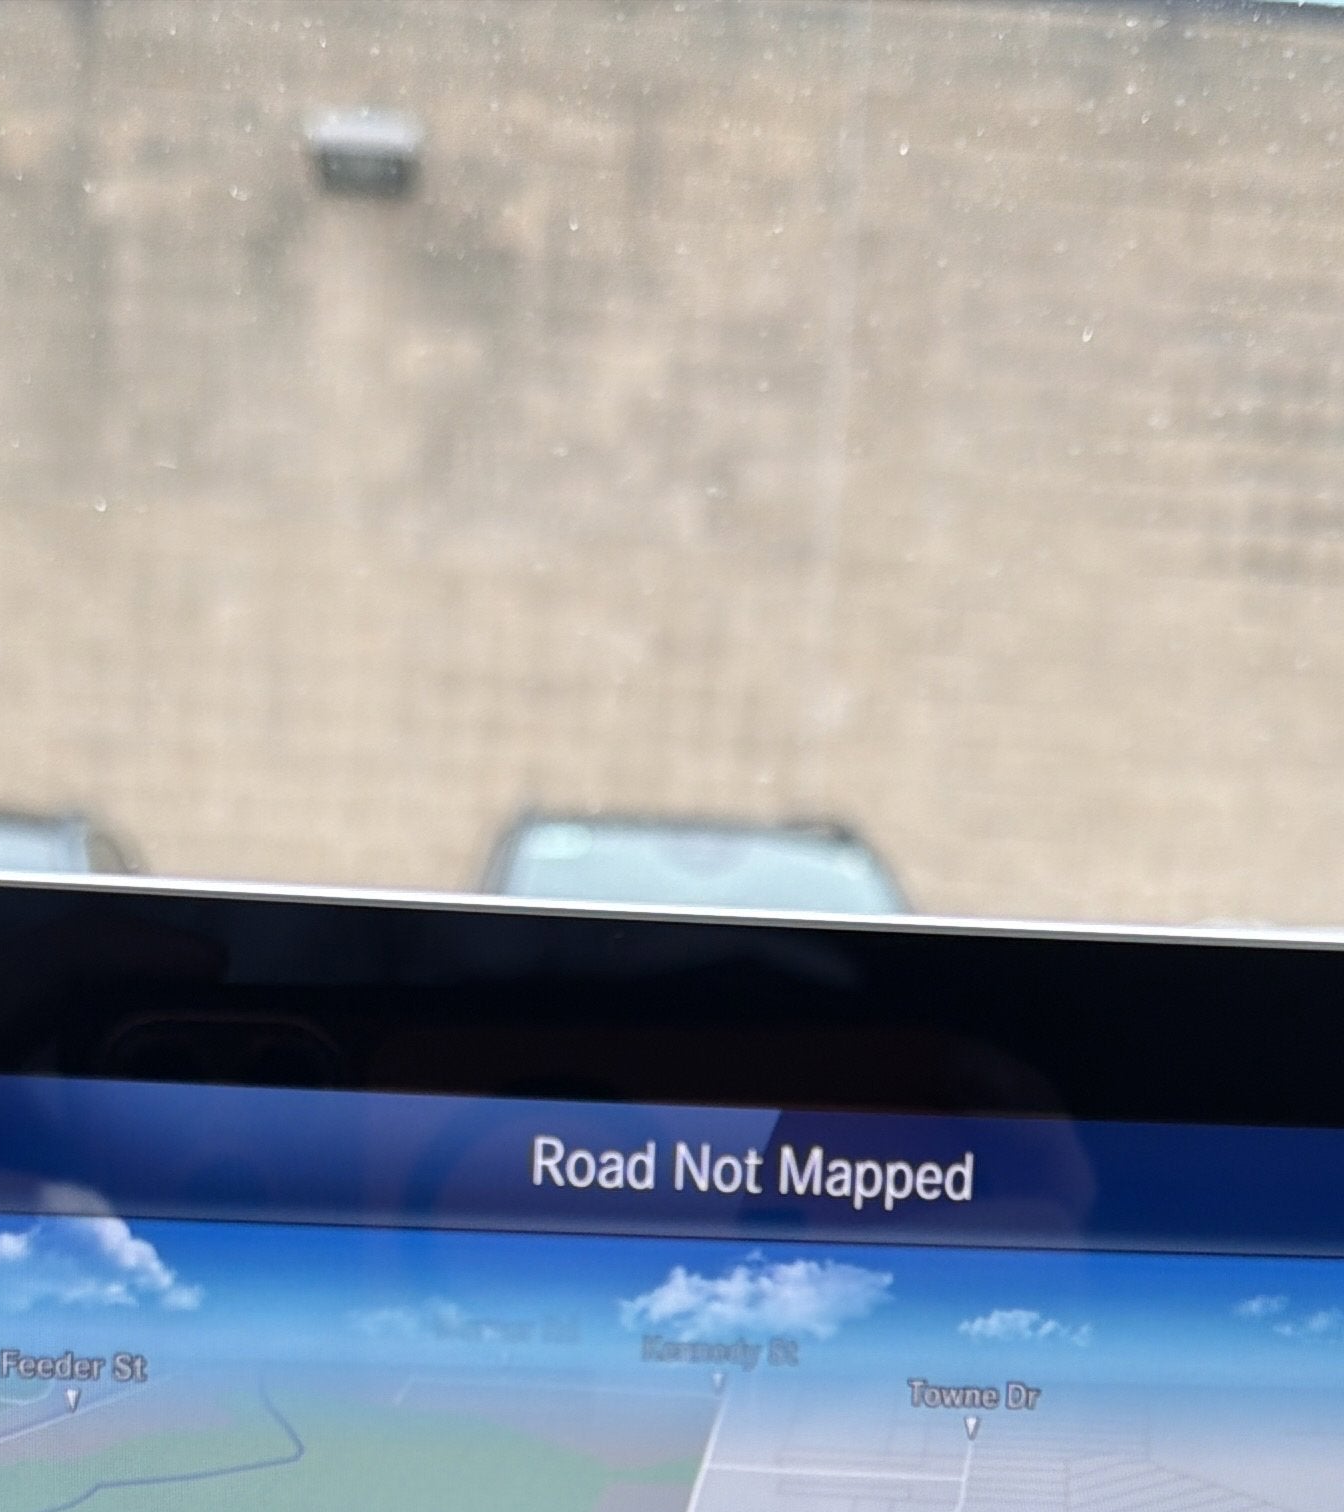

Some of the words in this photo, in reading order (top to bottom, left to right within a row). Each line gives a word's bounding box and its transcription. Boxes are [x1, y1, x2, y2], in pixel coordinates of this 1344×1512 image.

[532, 1136, 655, 1191] Road
[674, 1142, 762, 1194] Not
[778, 1145, 975, 1210] Mapped
[0, 1350, 104, 1381] Feeder
[112, 1353, 147, 1383] St
[907, 1379, 999, 1410] Towne
[1006, 1382, 1041, 1412] Dr
